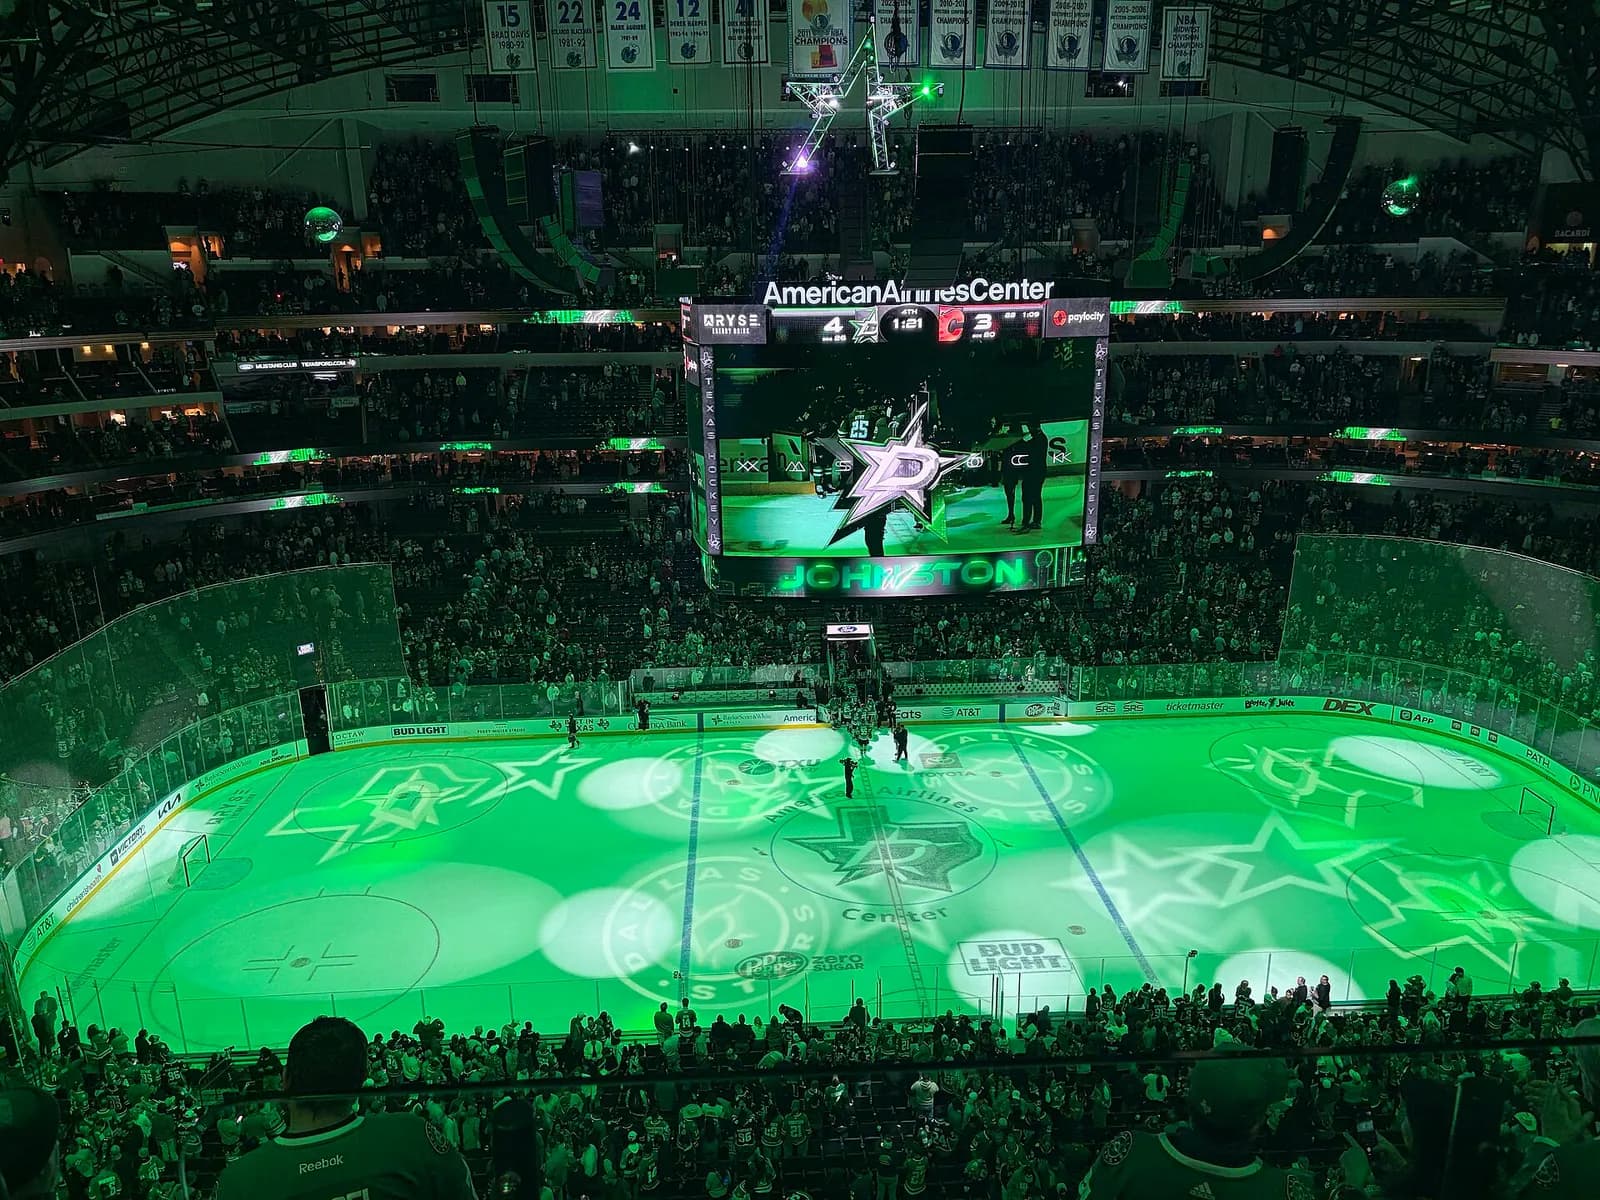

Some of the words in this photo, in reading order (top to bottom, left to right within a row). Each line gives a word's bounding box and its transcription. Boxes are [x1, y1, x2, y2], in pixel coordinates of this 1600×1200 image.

[497, 5, 520, 27] 15
[558, 1, 583, 24] 22
[615, 1, 641, 21] 24
[676, 0, 700, 17] 12
[1053, 19, 1088, 28] CHAMPIONS
[1112, 22, 1148, 30] CHAMPIONS
[1176, 15, 1197, 25] NBA
[491, 31, 509, 39] BRAD
[510, 31, 530, 39] DAVIS
[794, 37, 848, 46] CHAMPIONS
[498, 41, 525, 49] 1980-92
[715, 314, 760, 327] RYSE
[823, 317, 843, 332] 4
[892, 318, 923, 329] 1:21
[974, 314, 993, 330] 3
[1068, 312, 1105, 324] paylocity
[1092, 369, 1102, 430] TEXAS
[705, 378, 716, 440] TEXAS
[850, 420, 869, 438] 25
[1088, 441, 1099, 515] HOCKEY
[707, 453, 718, 525] HOCKEY
[780, 557, 1026, 590] JOHNSTON
[956, 708, 981, 717] AT&T
[1166, 701, 1224, 711] ticketmaster
[1323, 698, 1376, 716] DEX
[666, 720, 687, 728] Bank
[1413, 714, 1434, 724] APP
[393, 727, 415, 736] BUD
[417, 726, 446, 735] LIGHT
[1526, 749, 1550, 768] PATH
[878, 786, 978, 814] Airlines
[1583, 784, 1600, 804] PN
[842, 907, 949, 923] Center
[35, 912, 55, 938] AT&T
[977, 942, 1045, 957] BUD
[812, 954, 864, 964] zero
[814, 962, 864, 971] SUGAR
[970, 955, 1062, 972] LIGHT
[299, 1153, 344, 1175] Reebok
